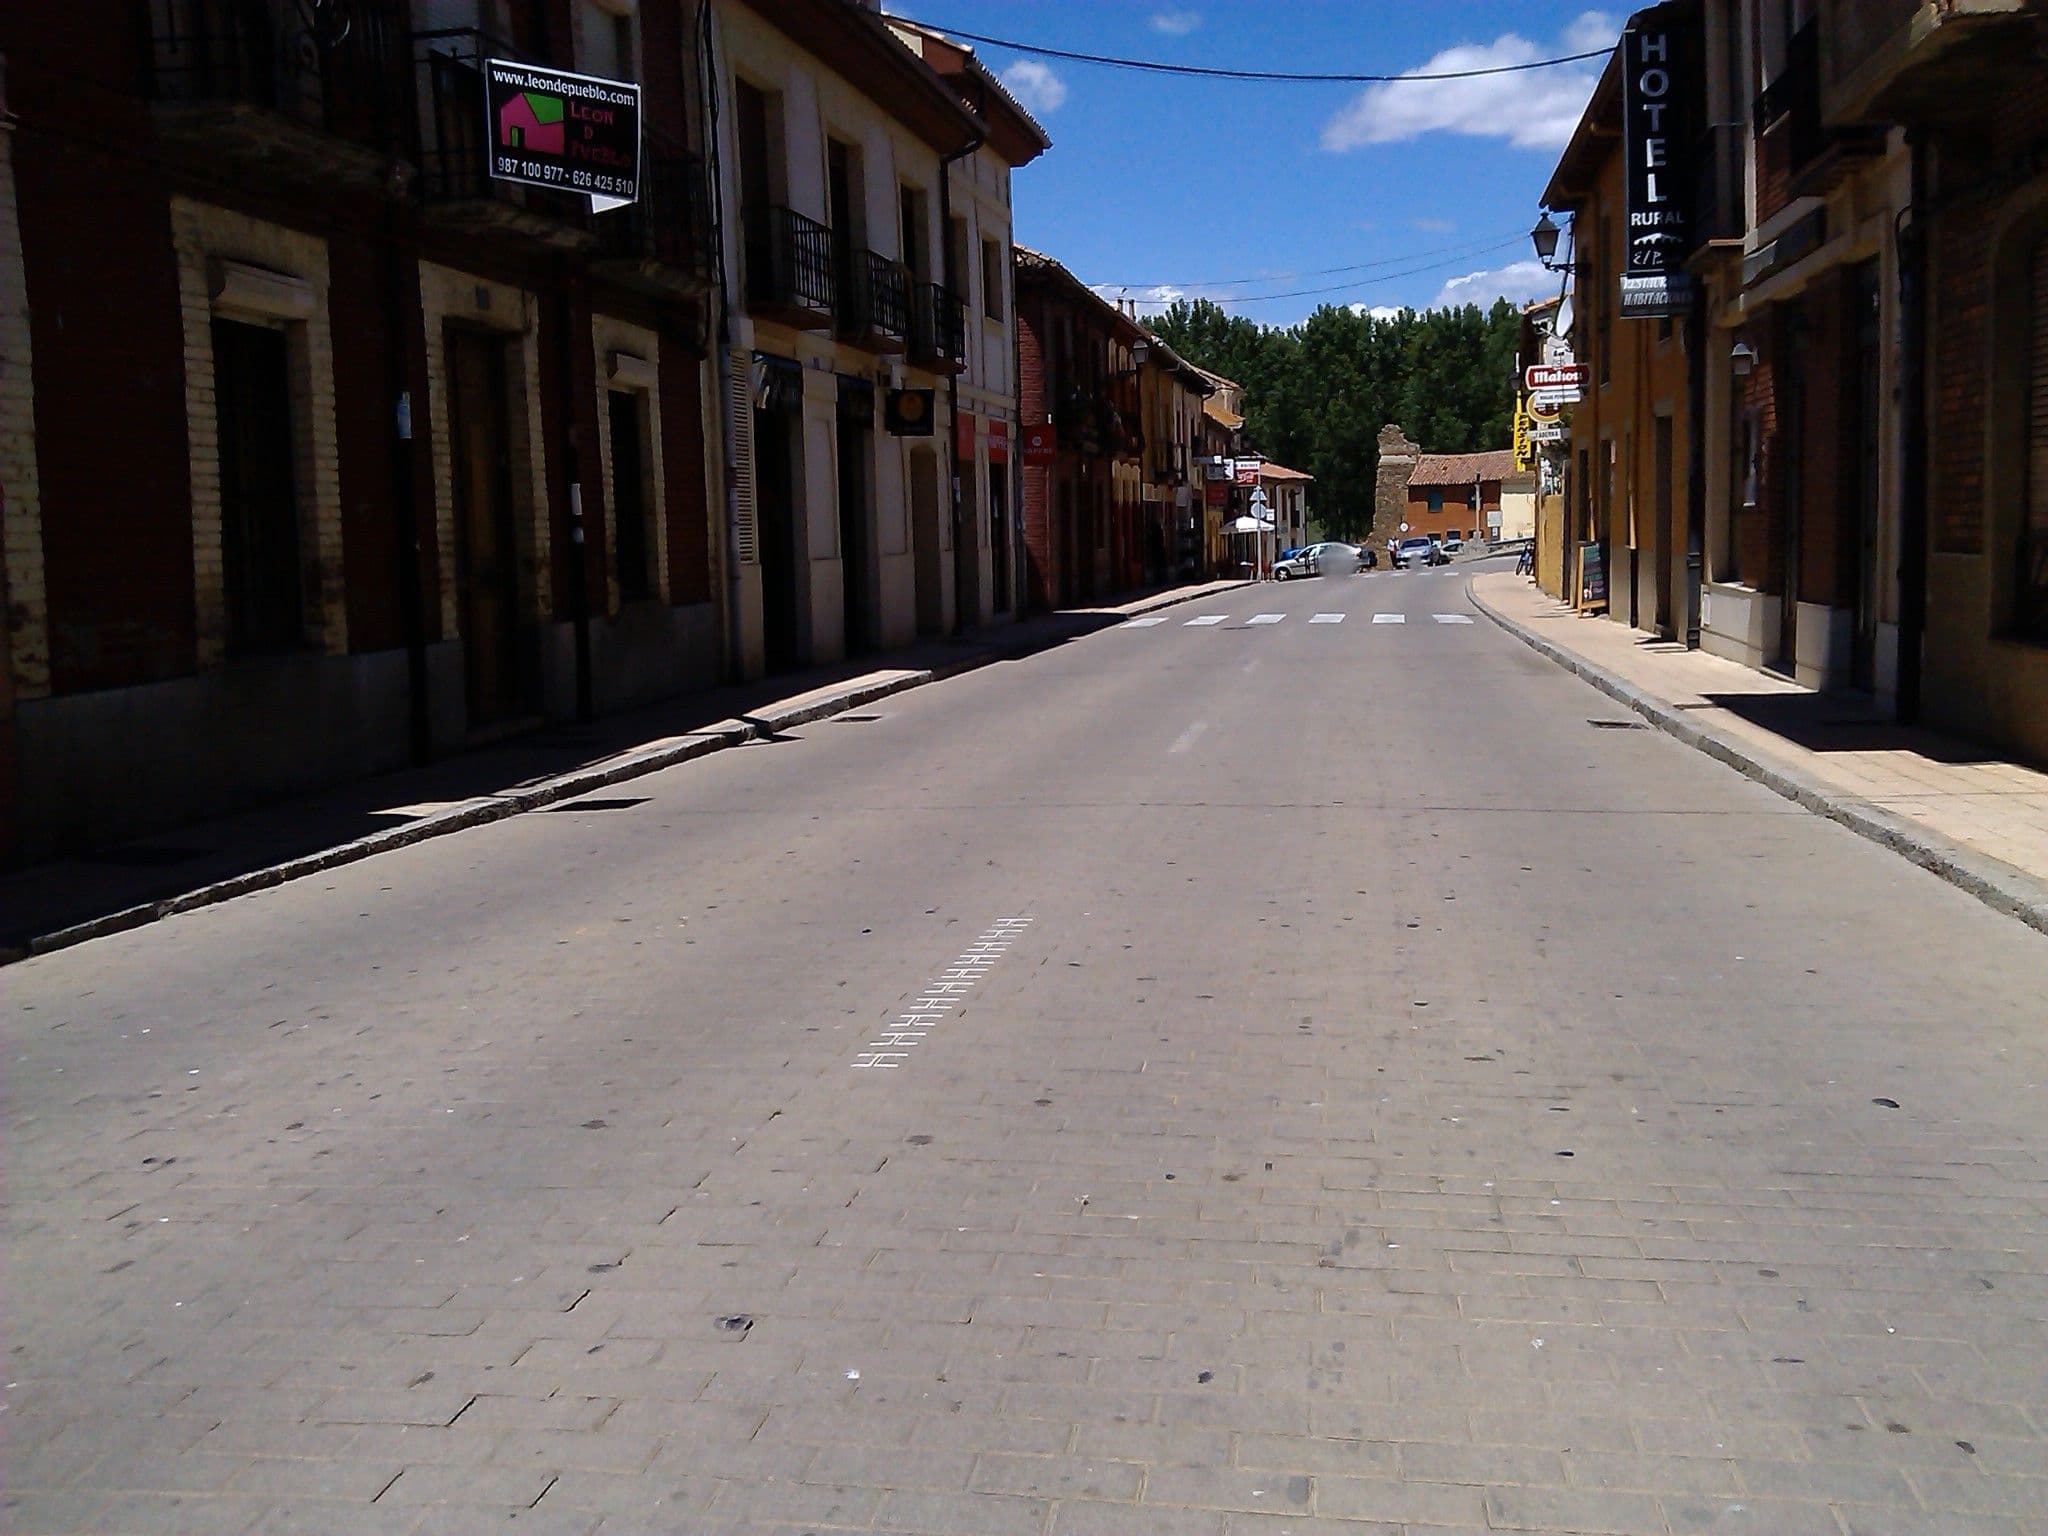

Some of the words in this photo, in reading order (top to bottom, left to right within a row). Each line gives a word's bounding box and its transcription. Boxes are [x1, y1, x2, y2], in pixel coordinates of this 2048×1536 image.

[492, 69, 636, 107] www.leondepueblo.com
[568, 98, 615, 126] LEON
[1639, 33, 1670, 204] HOTEL
[497, 156, 519, 174] 987
[521, 161, 541, 178] 100
[572, 169, 592, 187] 626
[594, 174, 613, 191] 425
[615, 178, 635, 195] 510
[1630, 211, 1686, 226] RURAL
[1533, 369, 1583, 384] Mahou
